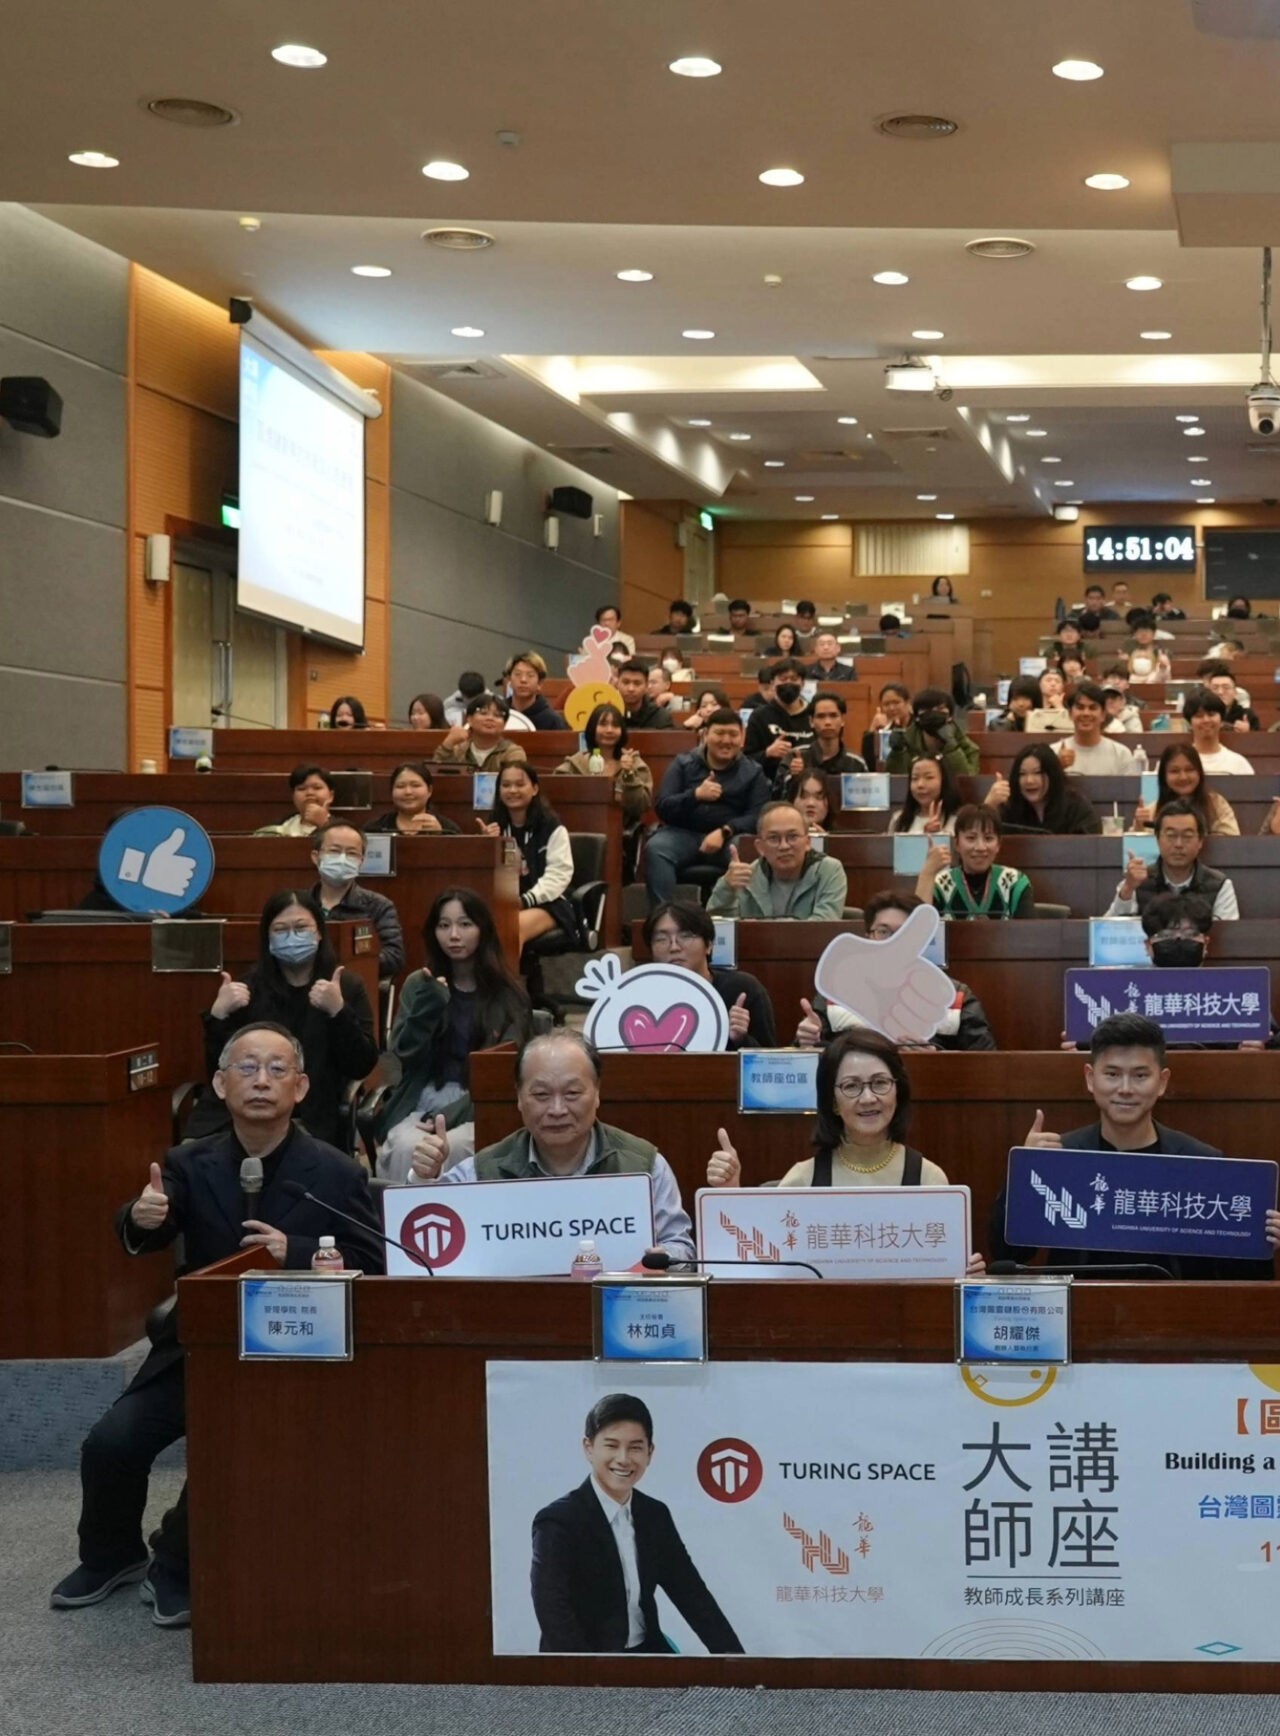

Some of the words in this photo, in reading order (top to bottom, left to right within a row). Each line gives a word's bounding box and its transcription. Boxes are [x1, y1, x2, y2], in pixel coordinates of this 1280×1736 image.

[1087, 537, 1194, 560] 14:51:04
[1144, 992, 1261, 1017] 龍華科技大學
[1113, 1189, 1252, 1222] 龍華科技大學
[481, 1220, 563, 1241] TURING
[569, 1217, 636, 1237] SPACE
[806, 1222, 947, 1249] 龍華科技大學
[268, 1321, 314, 1336] 陳元和
[627, 1323, 676, 1339] 林如貞
[993, 1326, 1040, 1341] 胡耀傑
[779, 1462, 861, 1480] TURING
[867, 1463, 936, 1481] SPACE
[1165, 1452, 1255, 1474] Building
[1263, 1458, 1275, 1471] a
[776, 1586, 884, 1604] 龍華科技大學
[964, 1586, 1125, 1607] 教師成長系列講座
